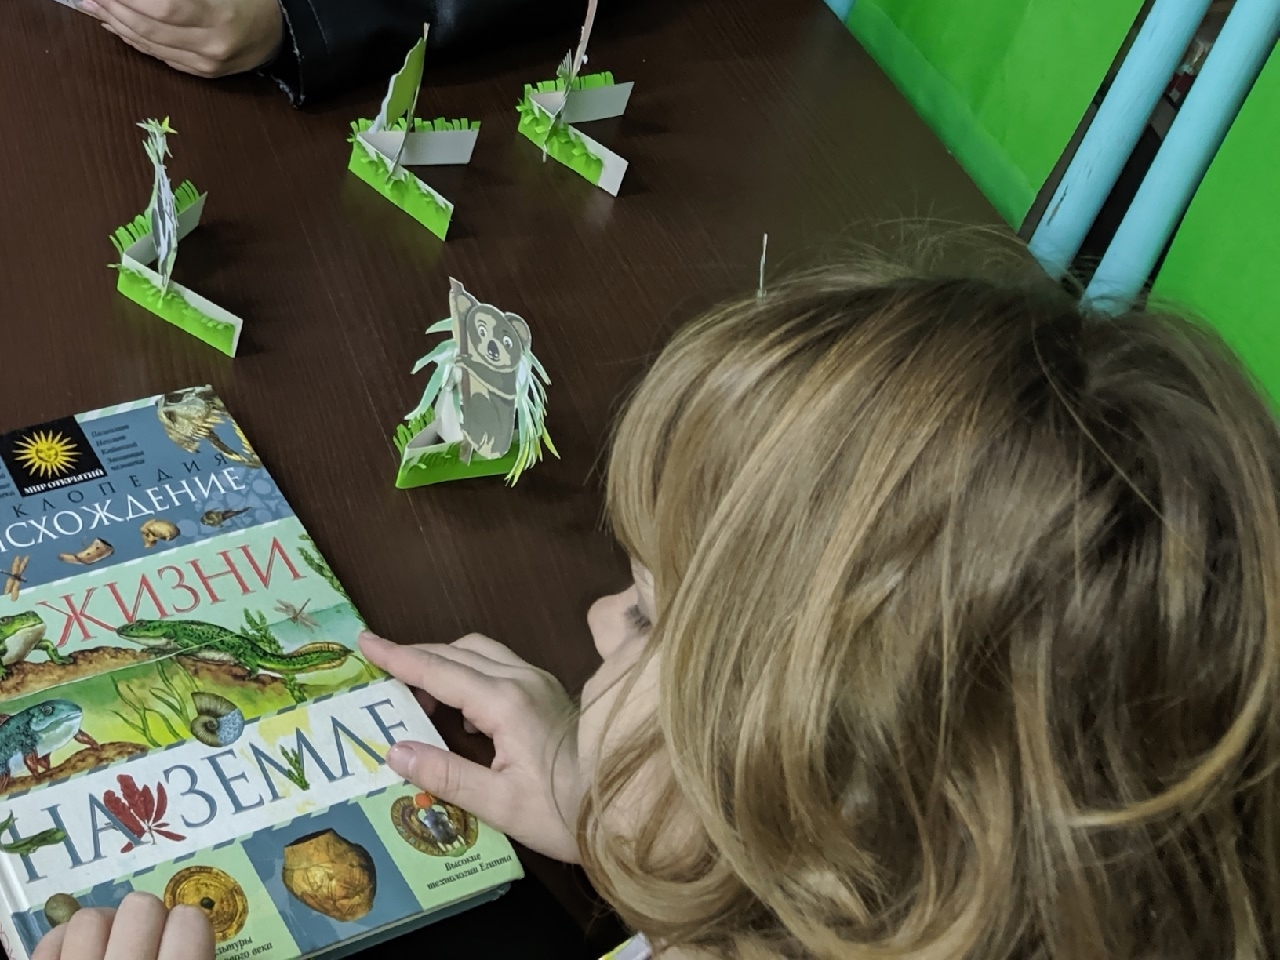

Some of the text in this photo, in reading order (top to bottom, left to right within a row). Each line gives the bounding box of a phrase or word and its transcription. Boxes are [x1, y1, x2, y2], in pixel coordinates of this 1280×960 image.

[37, 534, 307, 649] ЖИЗНИ
[4, 698, 411, 884] НА ЗЕМЛЕ
[426, 854, 513, 891] технологии Египта
[444, 852, 483, 872] Высокие
[251, 942, 274, 956] века
